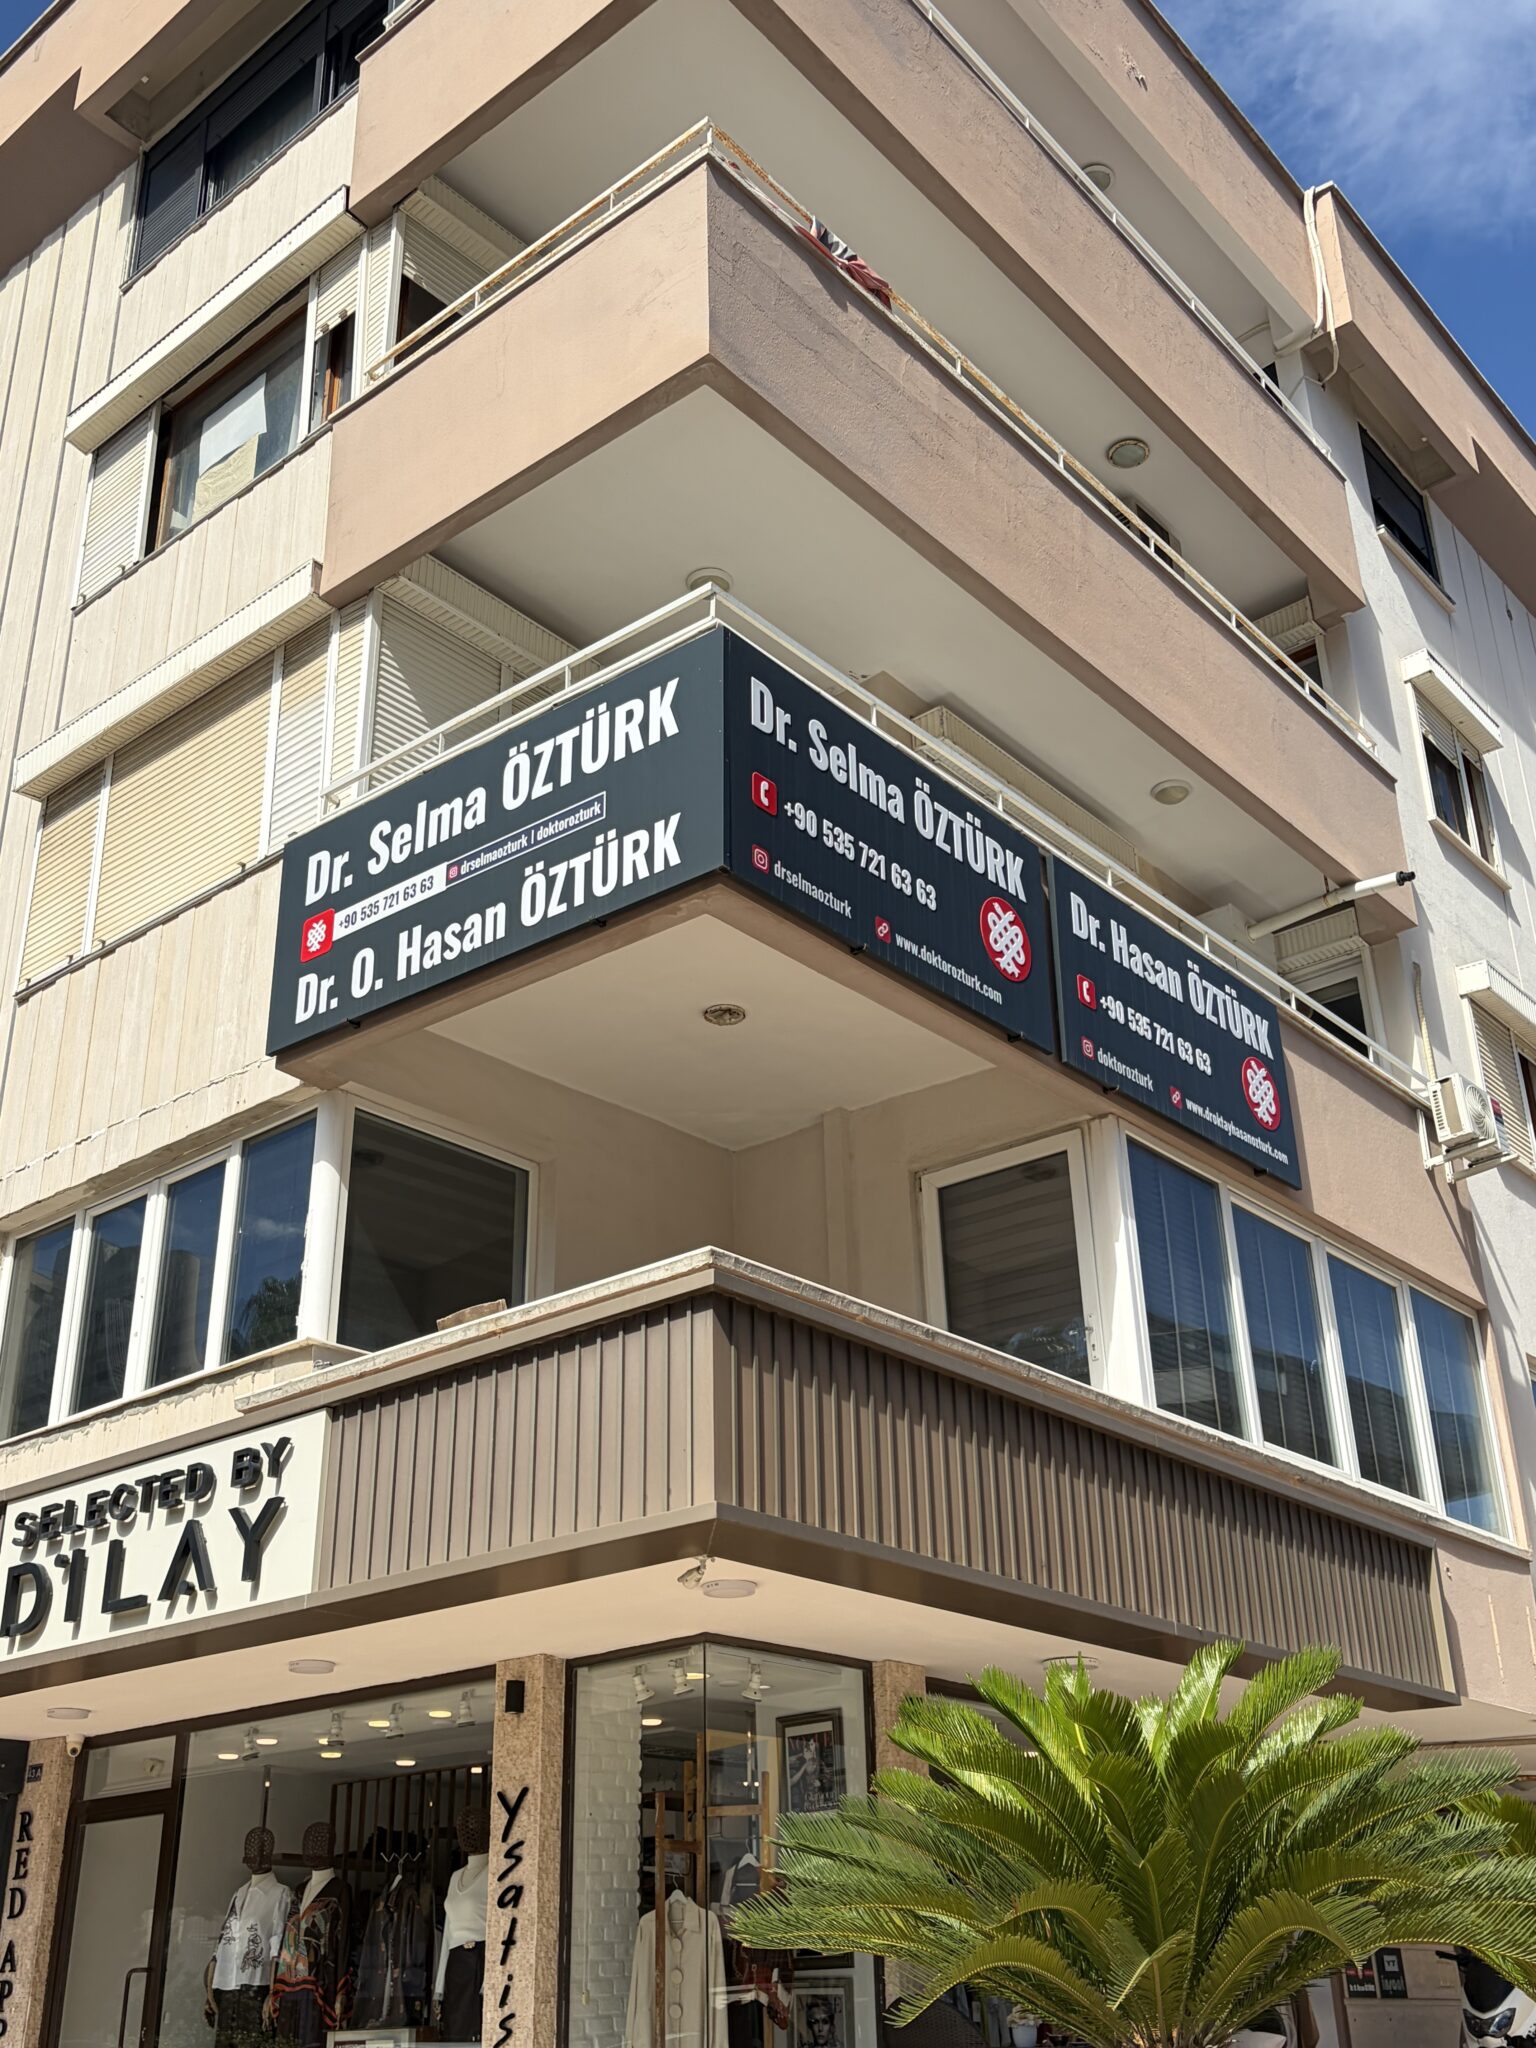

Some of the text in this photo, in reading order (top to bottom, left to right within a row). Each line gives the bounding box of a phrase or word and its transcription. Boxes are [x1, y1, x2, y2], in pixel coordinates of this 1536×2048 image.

[305, 677, 679, 906] Dr. Selma ÖZTÜRK
[750, 676, 1028, 903] Dr. Selma ÖZTÜRK
[460, 834, 528, 875] drselmaozturk
[537, 801, 601, 841] doktorozturk
[784, 801, 938, 911] +90 535 721 63 63
[294, 813, 682, 1024] Dr. O. Hasan ÖZTÜRK
[338, 876, 434, 930] +90 535 721 63 63
[773, 860, 852, 919] drselmaozturk
[895, 933, 1003, 1005] www.doktorozturk.com
[1070, 891, 1274, 1061] Dr. Hasan ÖZTÜRK
[1097, 1047, 1154, 1092] doktorozturk
[1100, 995, 1212, 1076] +90 535 721 63 63
[1185, 1097, 1289, 1165] www.droktayhasanozturk.com
[12, 1436, 292, 1547] SELECTED BY
[7, 1811, 34, 1920] RED
